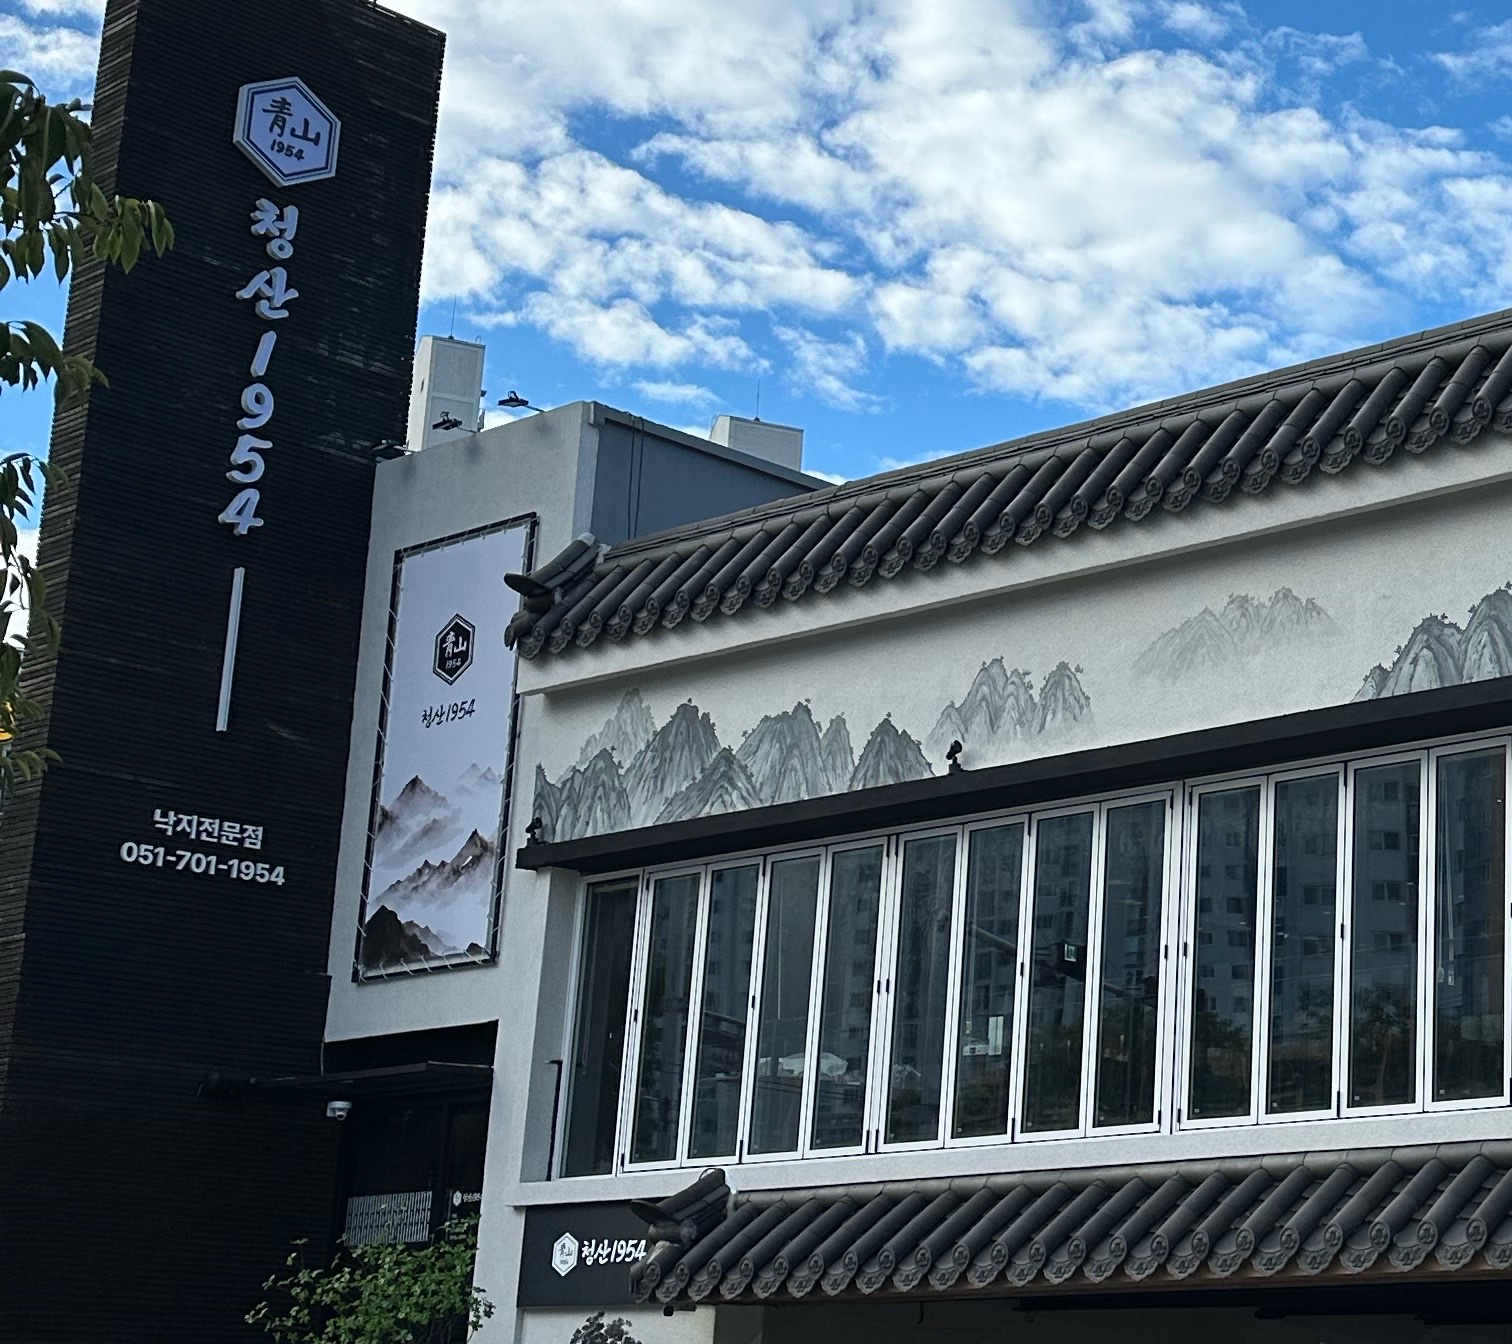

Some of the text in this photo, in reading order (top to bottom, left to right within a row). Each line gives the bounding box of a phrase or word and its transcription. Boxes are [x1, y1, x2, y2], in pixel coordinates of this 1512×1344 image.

[262, 96, 321, 147] 青山
[270, 138, 305, 161] 1954
[442, 630, 468, 658] 青山
[421, 698, 476, 729] 청산1954
[153, 808, 264, 850] 낙지전문점
[119, 841, 285, 886] 051-701-1954
[581, 1239, 647, 1266] 청산1954
